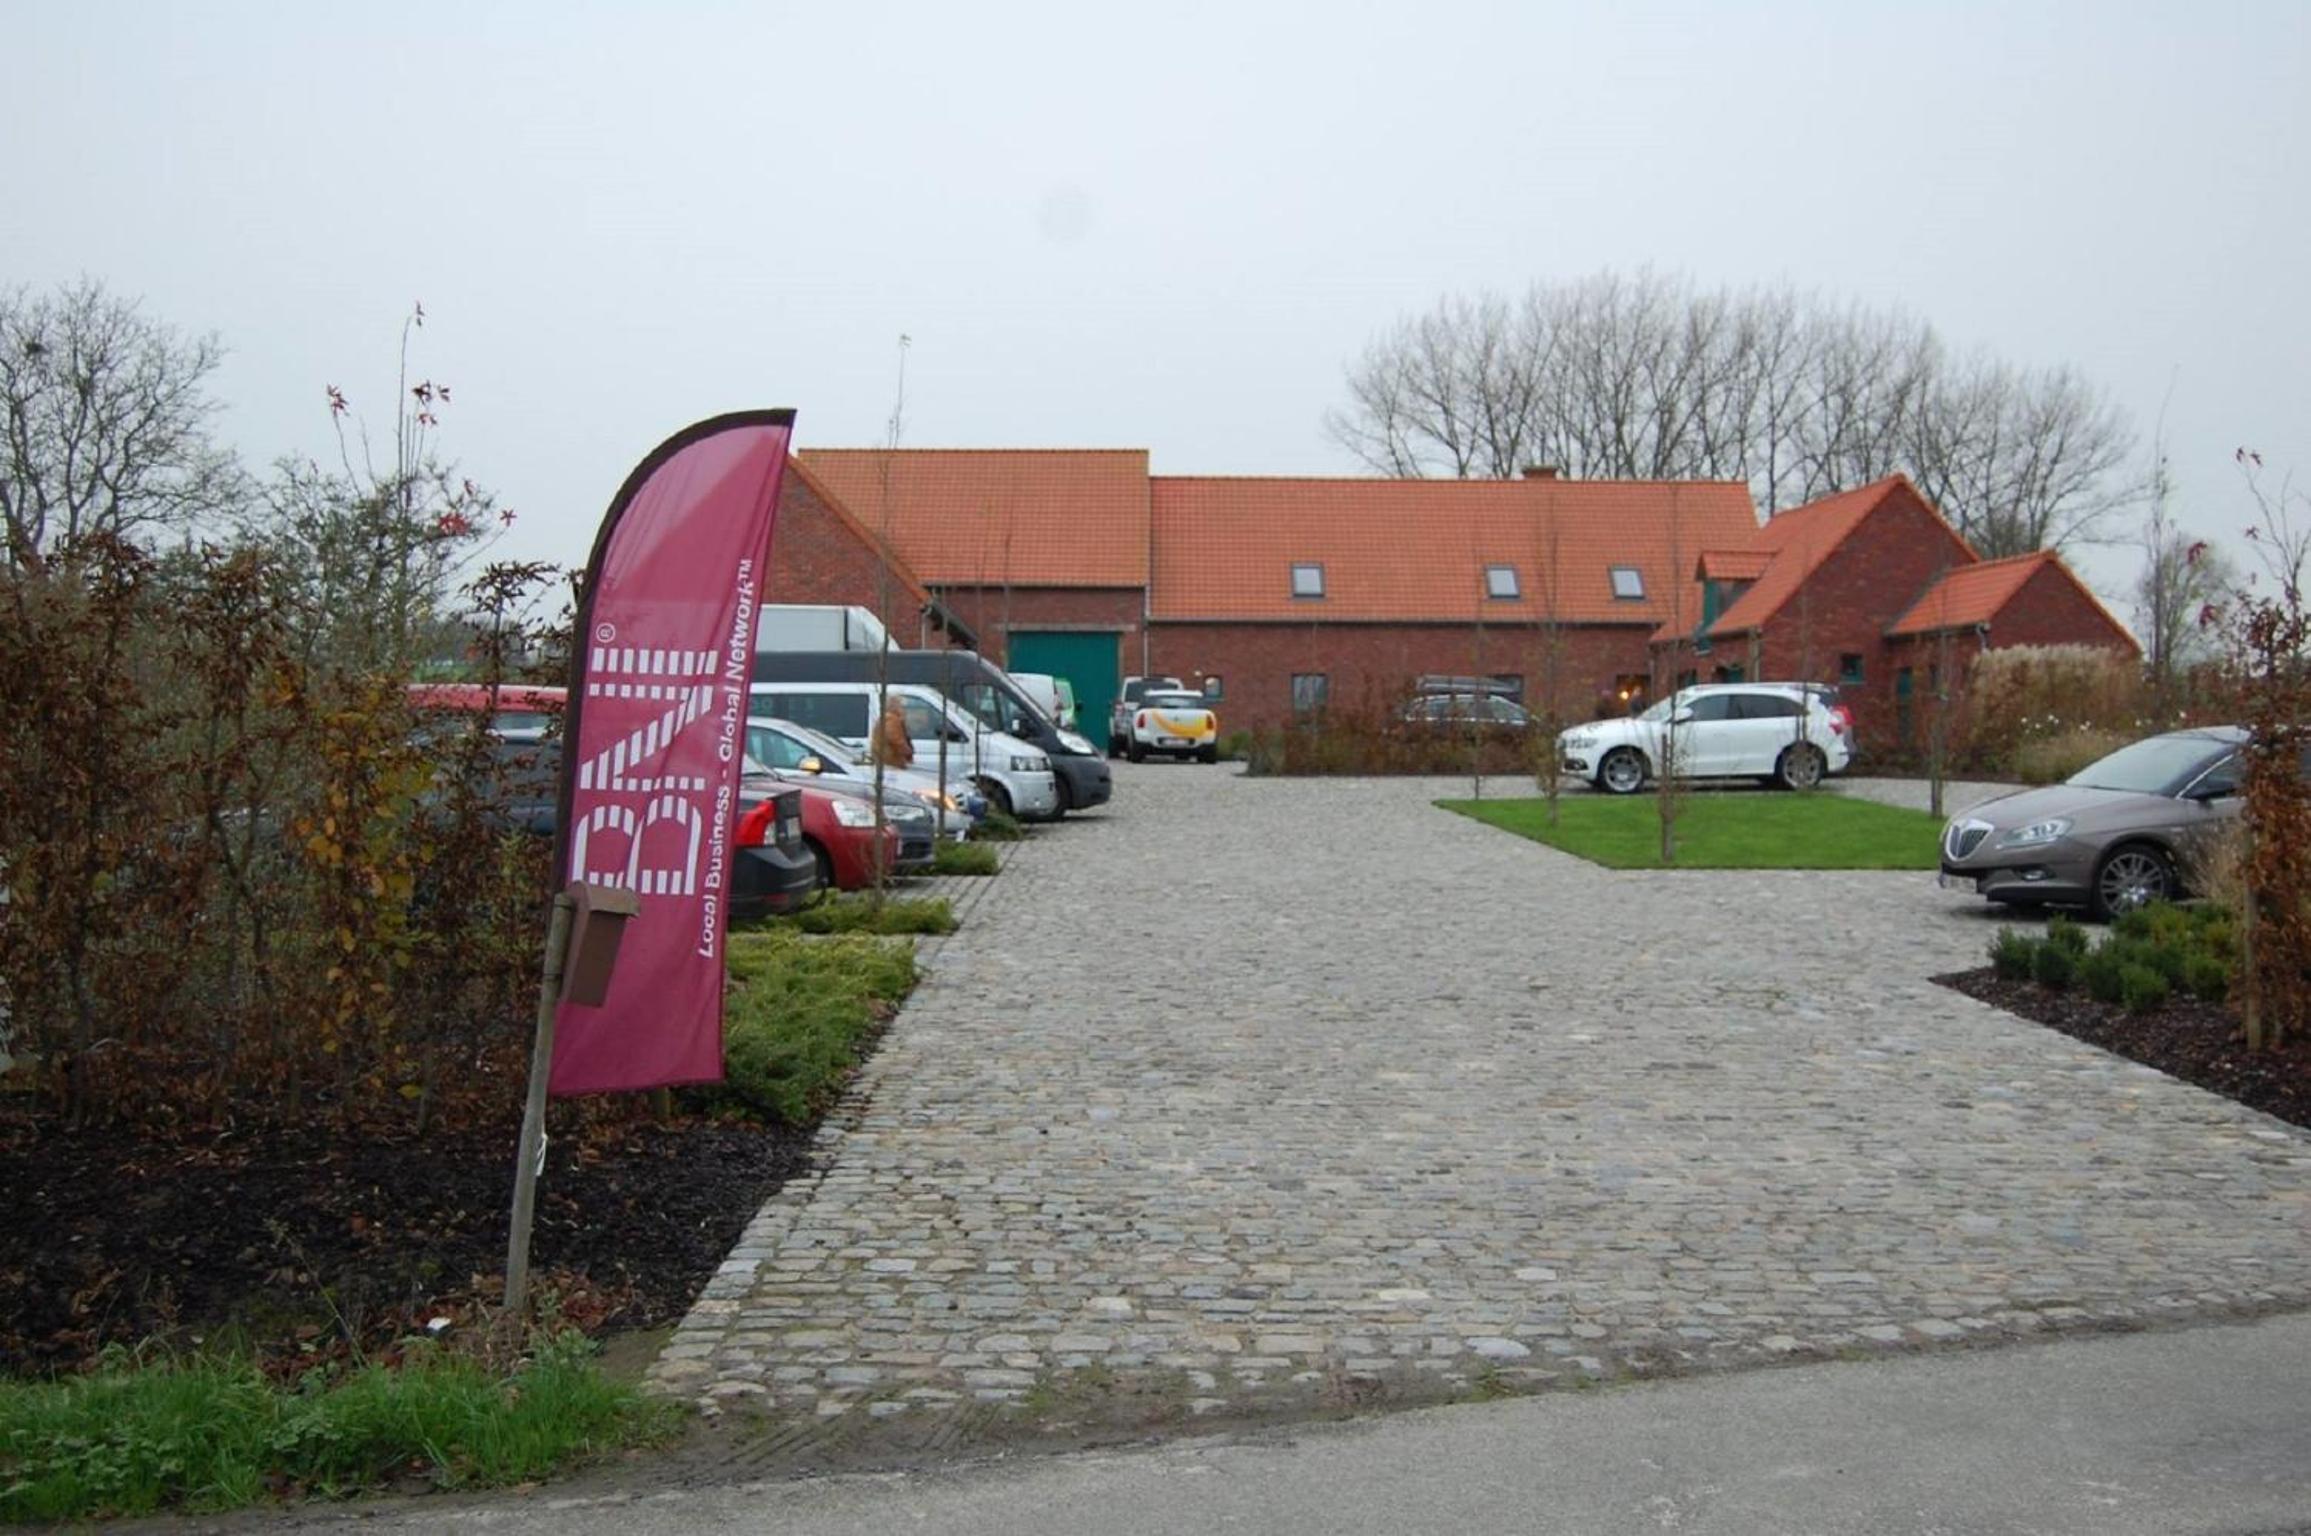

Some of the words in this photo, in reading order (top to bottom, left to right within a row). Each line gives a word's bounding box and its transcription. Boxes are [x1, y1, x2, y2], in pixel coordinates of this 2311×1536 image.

[719, 685, 742, 761] Global
[705, 785, 731, 888] Business
[698, 895, 718, 958] Local
